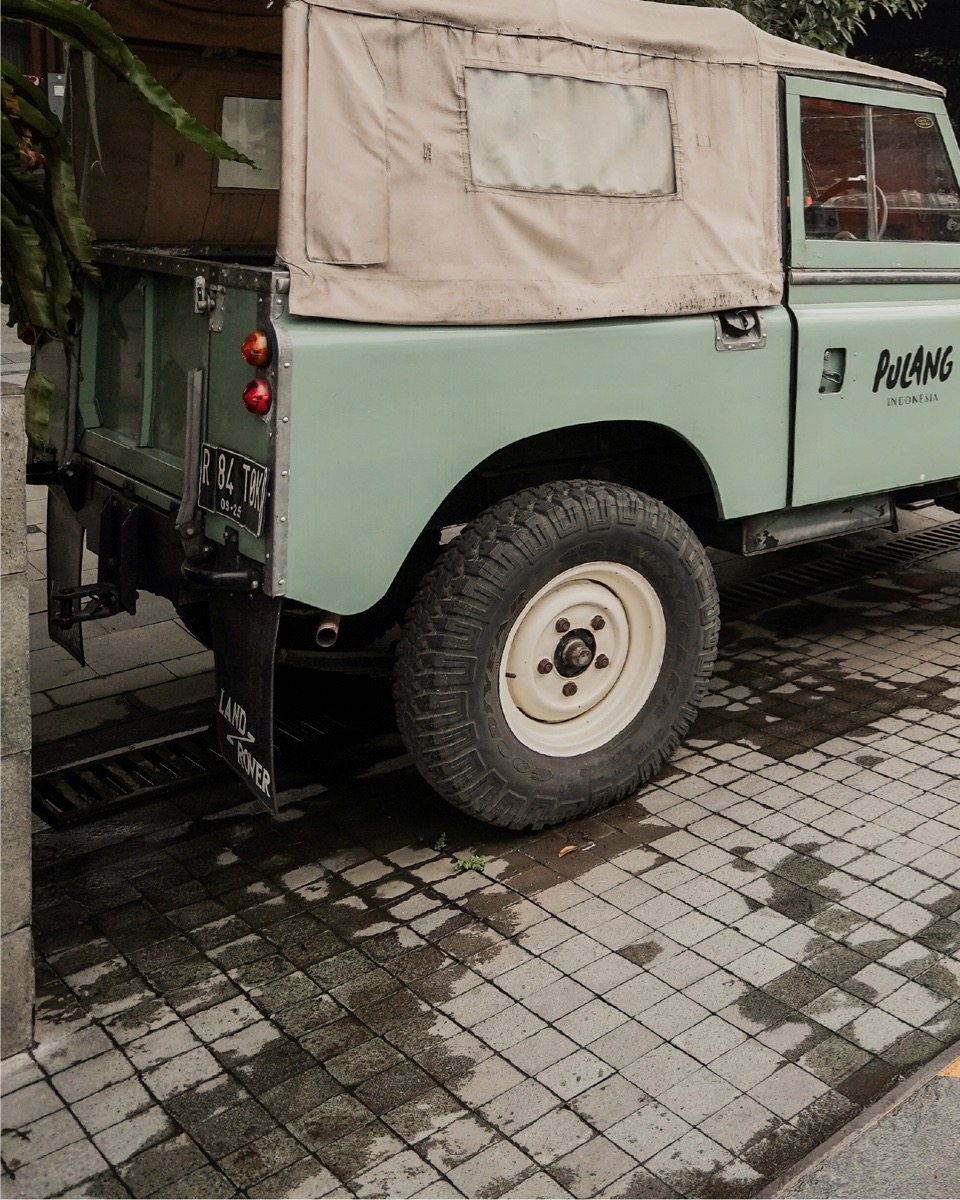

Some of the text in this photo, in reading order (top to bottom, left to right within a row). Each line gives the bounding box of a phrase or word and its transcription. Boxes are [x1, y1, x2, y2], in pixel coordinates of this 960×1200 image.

[872, 345, 954, 393] PULANG
[887, 394, 939, 407] INDONESIA
[202, 448, 210, 486] R
[218, 453, 234, 496] 84
[219, 688, 247, 736] LAND
[237, 740, 271, 798] ROVER
